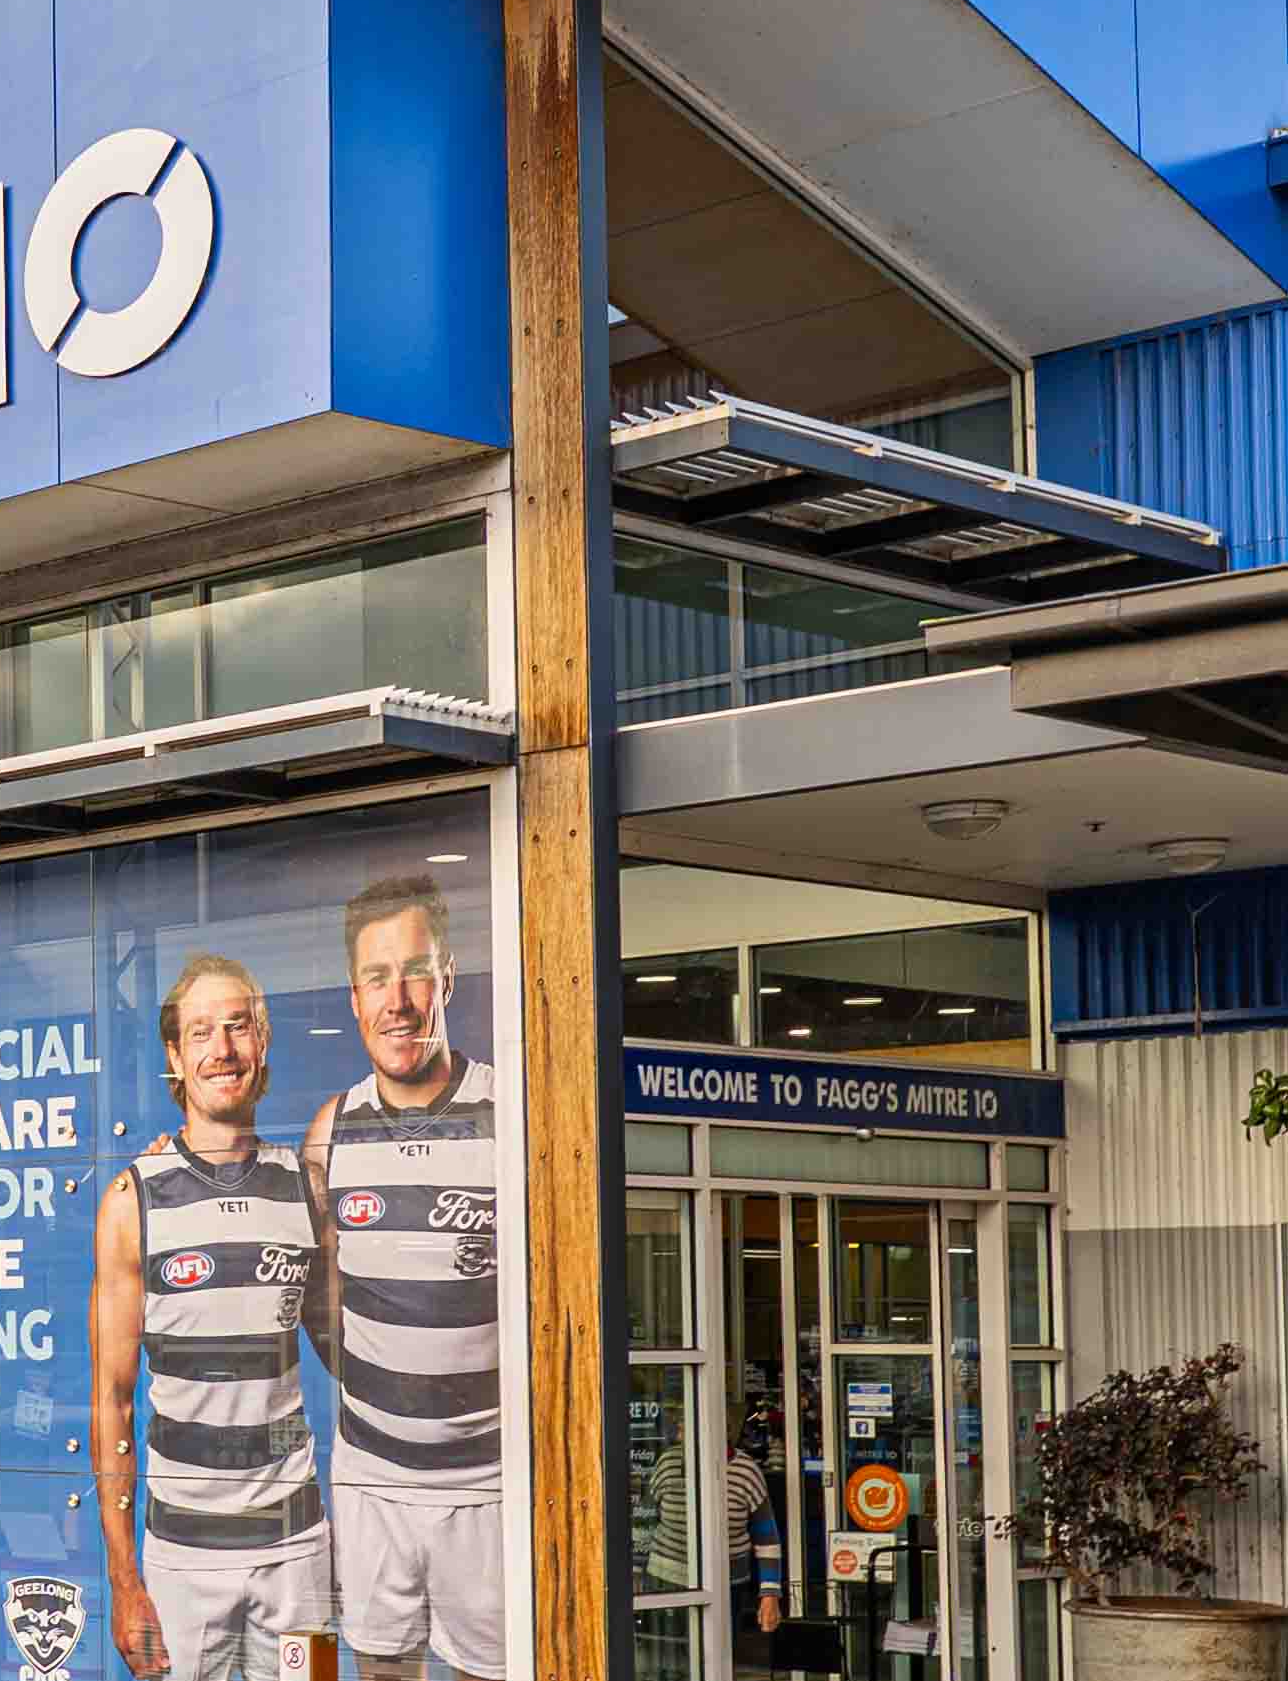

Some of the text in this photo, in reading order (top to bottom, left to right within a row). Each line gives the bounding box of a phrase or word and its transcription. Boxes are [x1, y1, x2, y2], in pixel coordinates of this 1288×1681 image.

[637, 1064, 998, 1118] WELCOME TO FAGG'S MITRE 10
[398, 1144, 431, 1157] YETI
[217, 1201, 249, 1213] YETI
[342, 1197, 380, 1218] AFL
[428, 1189, 498, 1231] For
[165, 1259, 209, 1280] AFL
[15, 1583, 74, 1602] GEELONG
